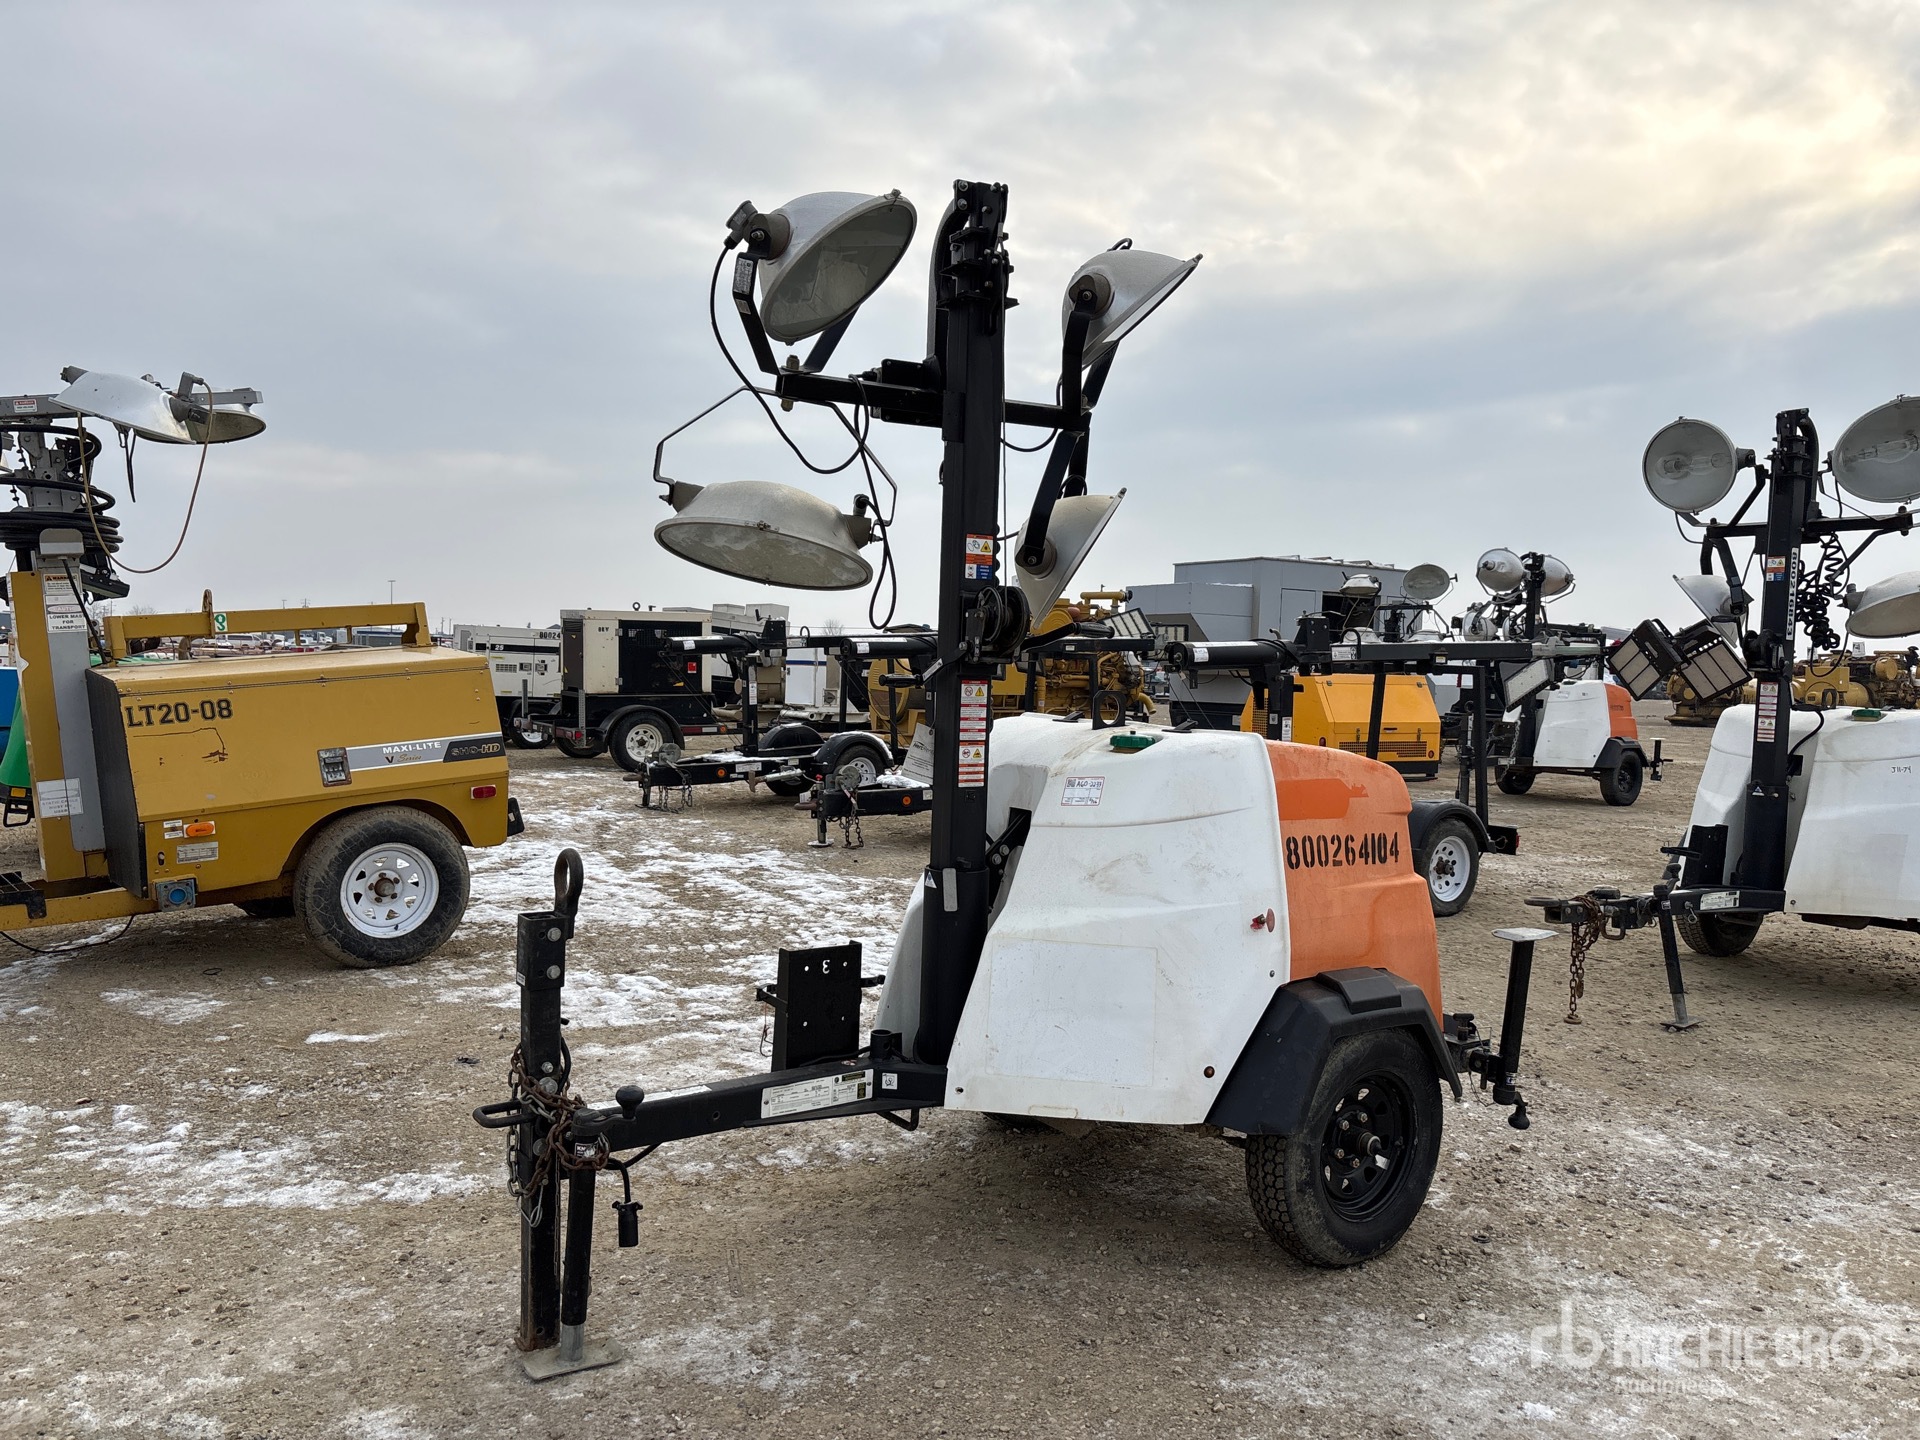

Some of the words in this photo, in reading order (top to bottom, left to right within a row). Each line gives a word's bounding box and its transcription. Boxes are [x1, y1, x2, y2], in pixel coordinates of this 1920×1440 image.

[124, 698, 233, 728] LT20-08
[382, 741, 442, 754] MAXI-LITE
[385, 755, 395, 764] V
[1285, 831, 1400, 870] 800264104
